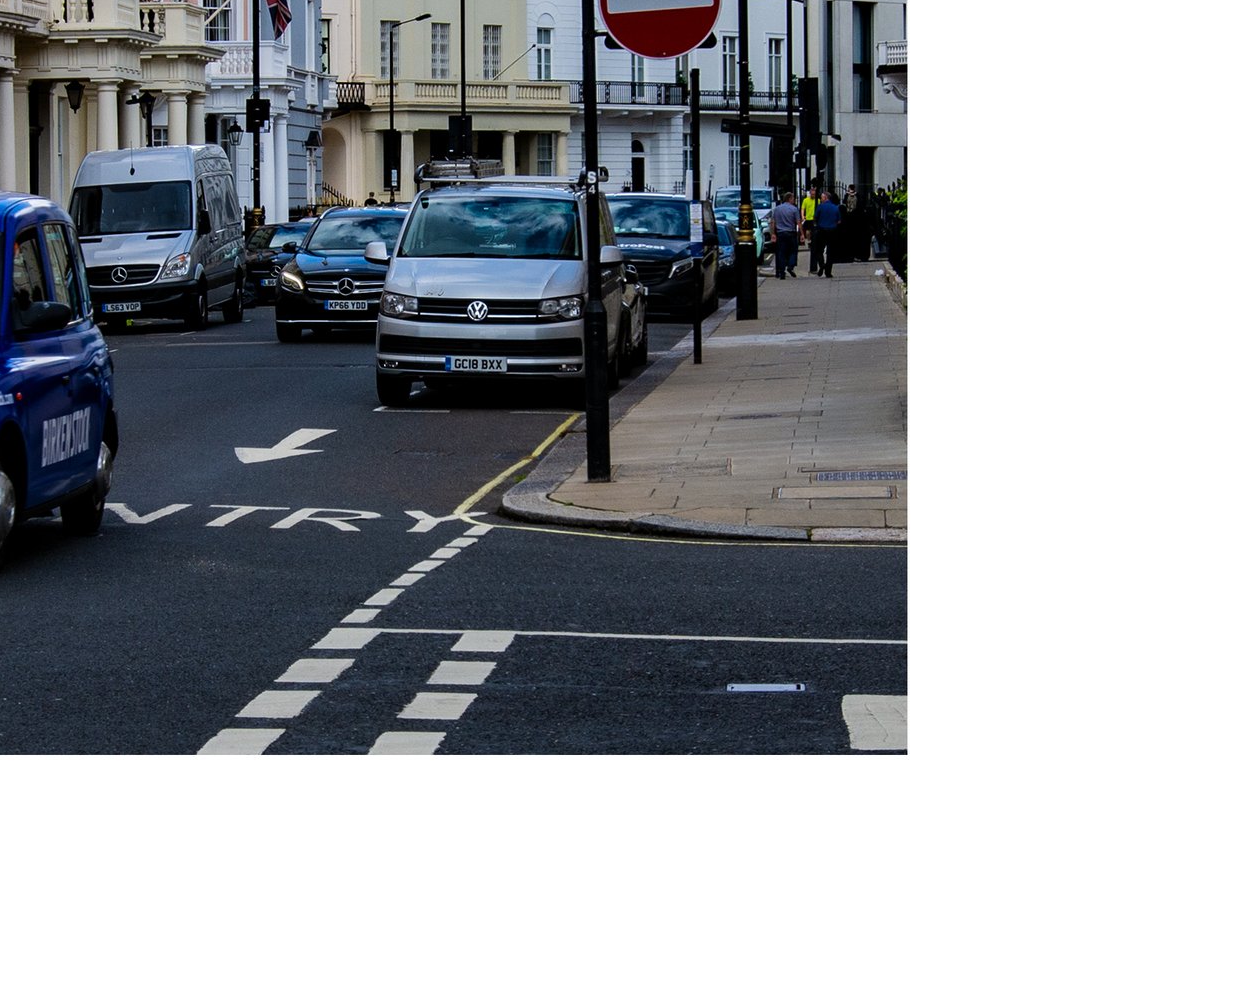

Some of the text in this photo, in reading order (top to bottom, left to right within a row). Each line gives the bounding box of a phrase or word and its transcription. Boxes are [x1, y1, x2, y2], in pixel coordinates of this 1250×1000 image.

[587, 171, 597, 184] S
[588, 185, 596, 194] 4
[617, 243, 666, 251] troPost
[329, 300, 349, 310] KP66
[454, 358, 503, 370] GC18 BXX
[104, 503, 488, 533] NTRY
